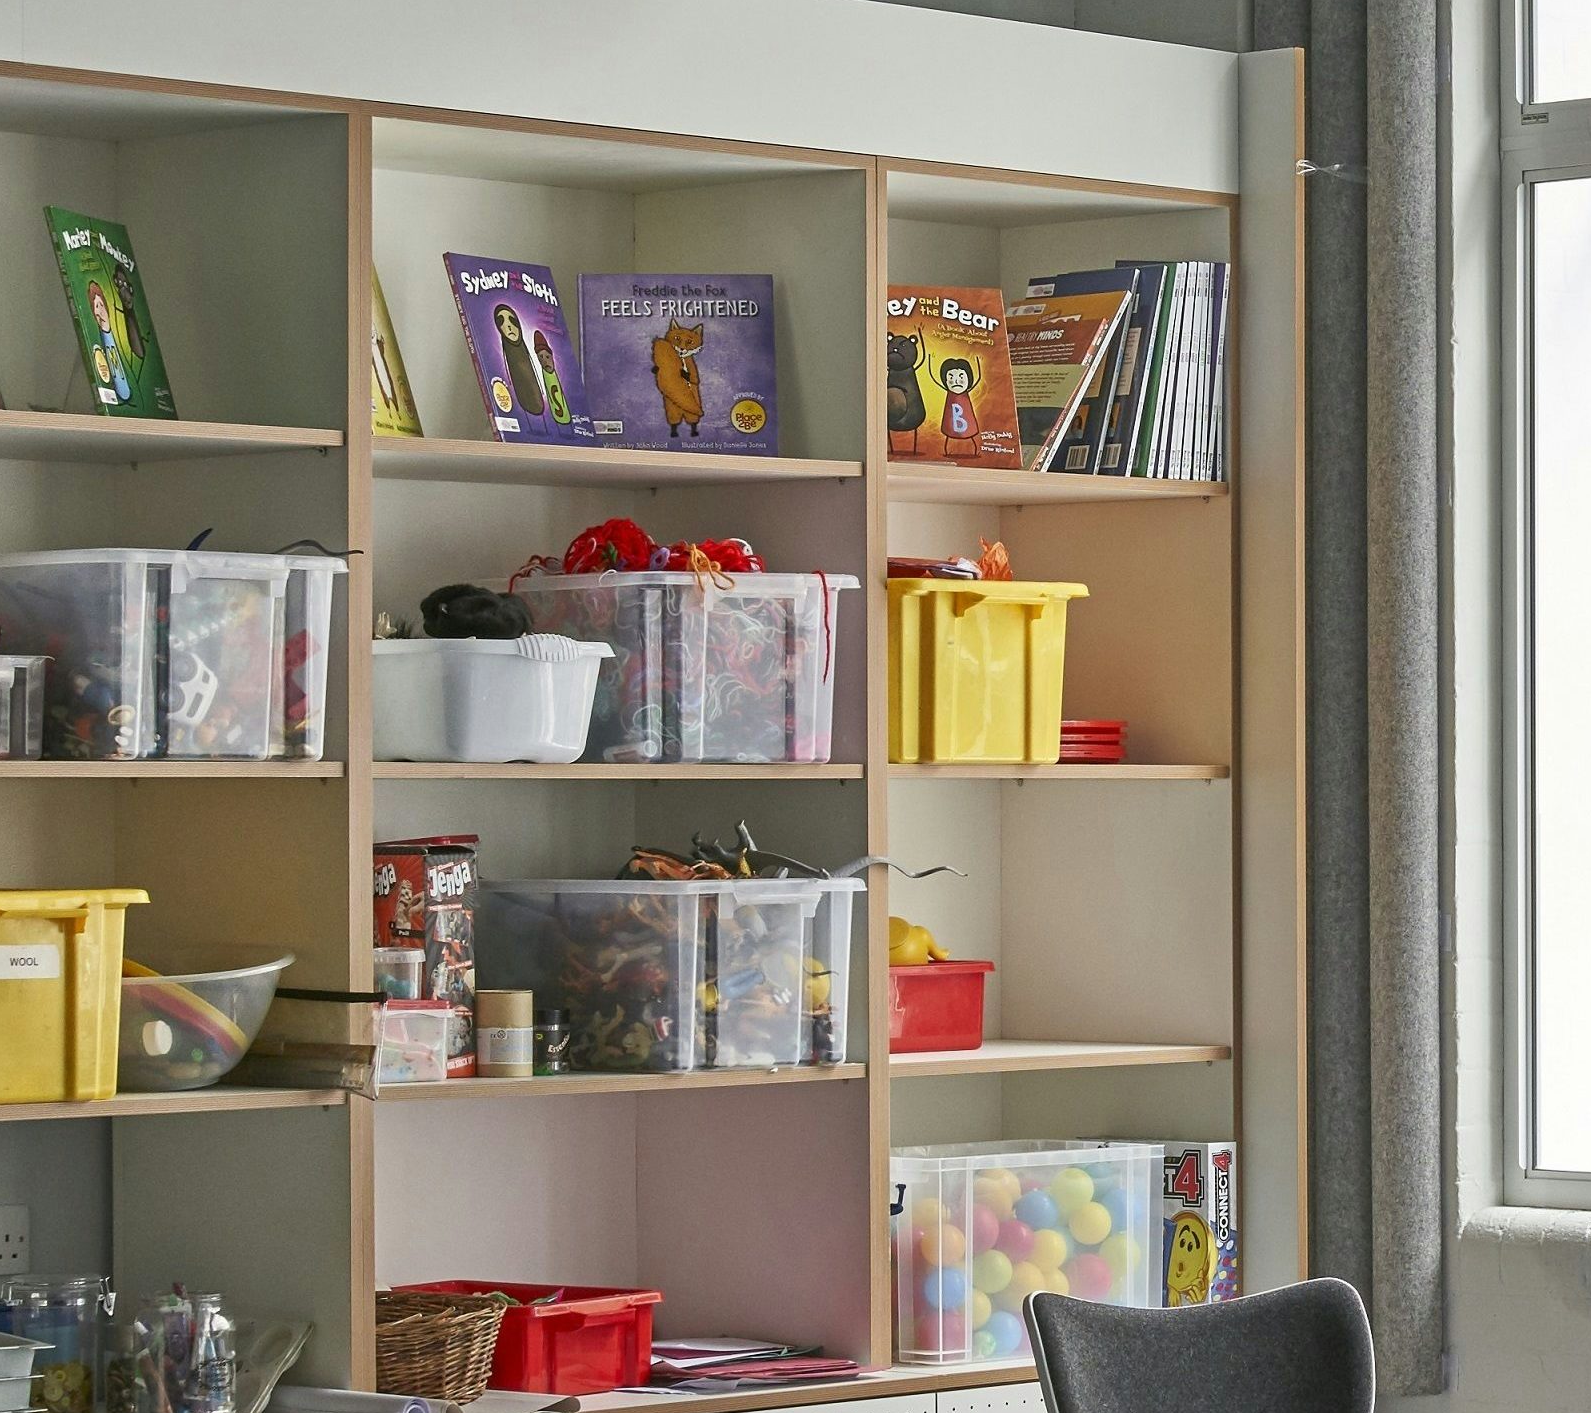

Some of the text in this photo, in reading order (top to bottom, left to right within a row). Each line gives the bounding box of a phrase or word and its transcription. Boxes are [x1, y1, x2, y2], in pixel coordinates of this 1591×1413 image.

[460, 268, 508, 295] Sydney
[521, 273, 558, 307] Sloth
[632, 284, 727, 297] Freddie the Fox
[601, 300, 760, 317] FEELS FRIGHTENED
[888, 296, 917, 317] ey
[918, 296, 940, 306] and
[942, 297, 1000, 332] Bear
[920, 305, 940, 317] the
[1036, 329, 1065, 342] MINDS
[550, 384, 564, 417] S
[735, 412, 762, 423] Place
[951, 402, 969, 434] B
[429, 861, 472, 898] Jenga
[9, 957, 39, 967] WOOL
[1218, 1169, 1229, 1240] CONNECT
